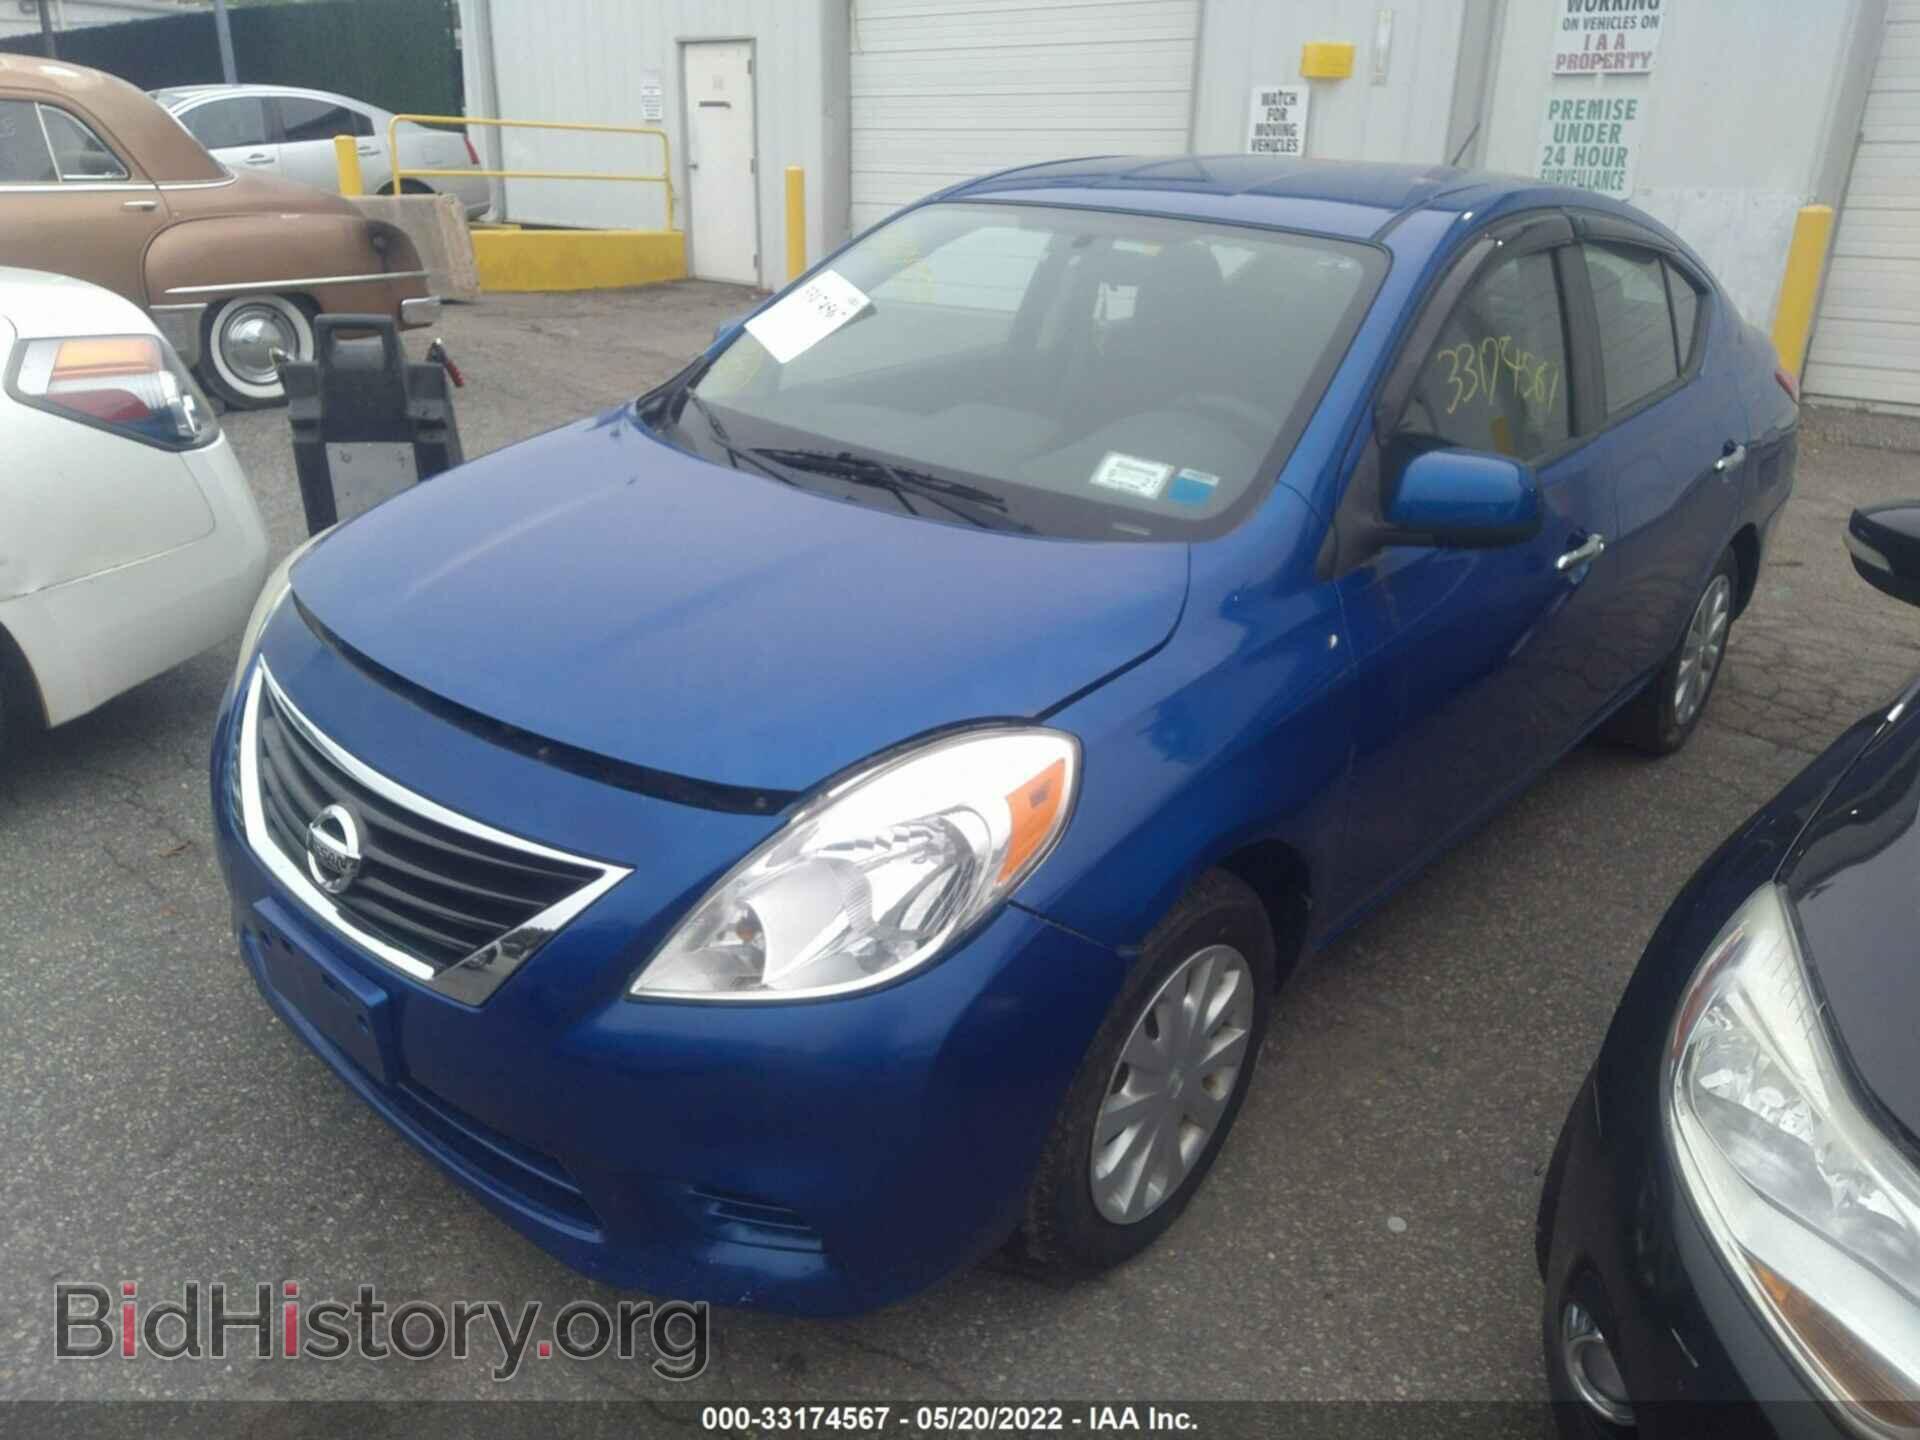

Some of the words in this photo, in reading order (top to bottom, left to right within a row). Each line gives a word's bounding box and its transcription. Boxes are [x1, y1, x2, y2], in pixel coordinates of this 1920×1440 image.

[1562, 18, 1579, 31] ON
[1583, 16, 1637, 30] VEHICLES
[1641, 15, 1660, 29] ON
[1555, 51, 1652, 70] PROPERTY
[1261, 91, 1297, 106] WATCH
[1267, 107, 1287, 121] FOR
[1548, 98, 1638, 121] PREMISE
[1255, 122, 1297, 136] MOVING
[1553, 122, 1622, 144] UNDER
[1251, 138, 1297, 152] VEHICLES
[1542, 145, 1565, 167] 24
[1574, 145, 1628, 168] HOUR
